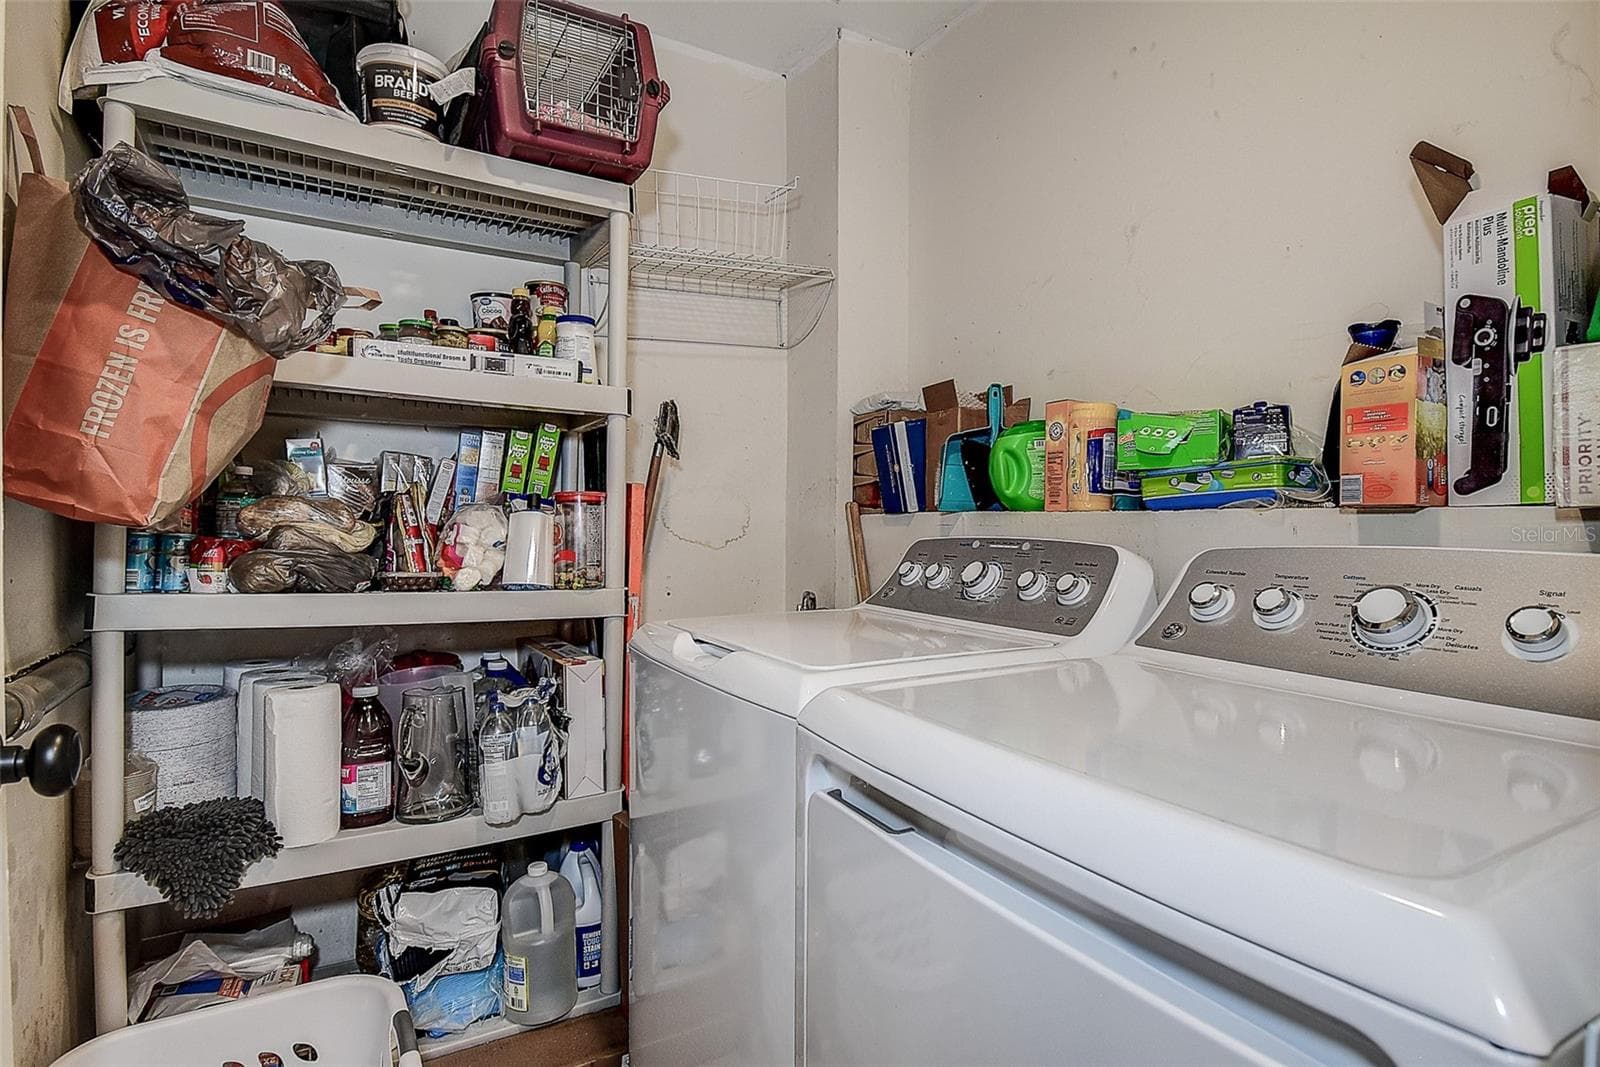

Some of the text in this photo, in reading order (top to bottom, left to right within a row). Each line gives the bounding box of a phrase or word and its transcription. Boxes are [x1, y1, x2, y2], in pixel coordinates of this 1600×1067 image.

[393, 89, 420, 101] BEEF
[1483, 215, 1494, 236] Plus
[1521, 204, 1536, 237] prep
[1497, 211, 1510, 286] Multi-Mandoline
[397, 350, 442, 359] Multifunctional
[413, 358, 442, 366] Organizer
[80, 351, 140, 440] FROZEN
[114, 324, 150, 351] IS
[1578, 416, 1592, 494] PRIORITY
[1274, 573, 1309, 581] Temperature
[1539, 589, 1566, 597] Signal
[1445, 642, 1479, 650] Delicates
